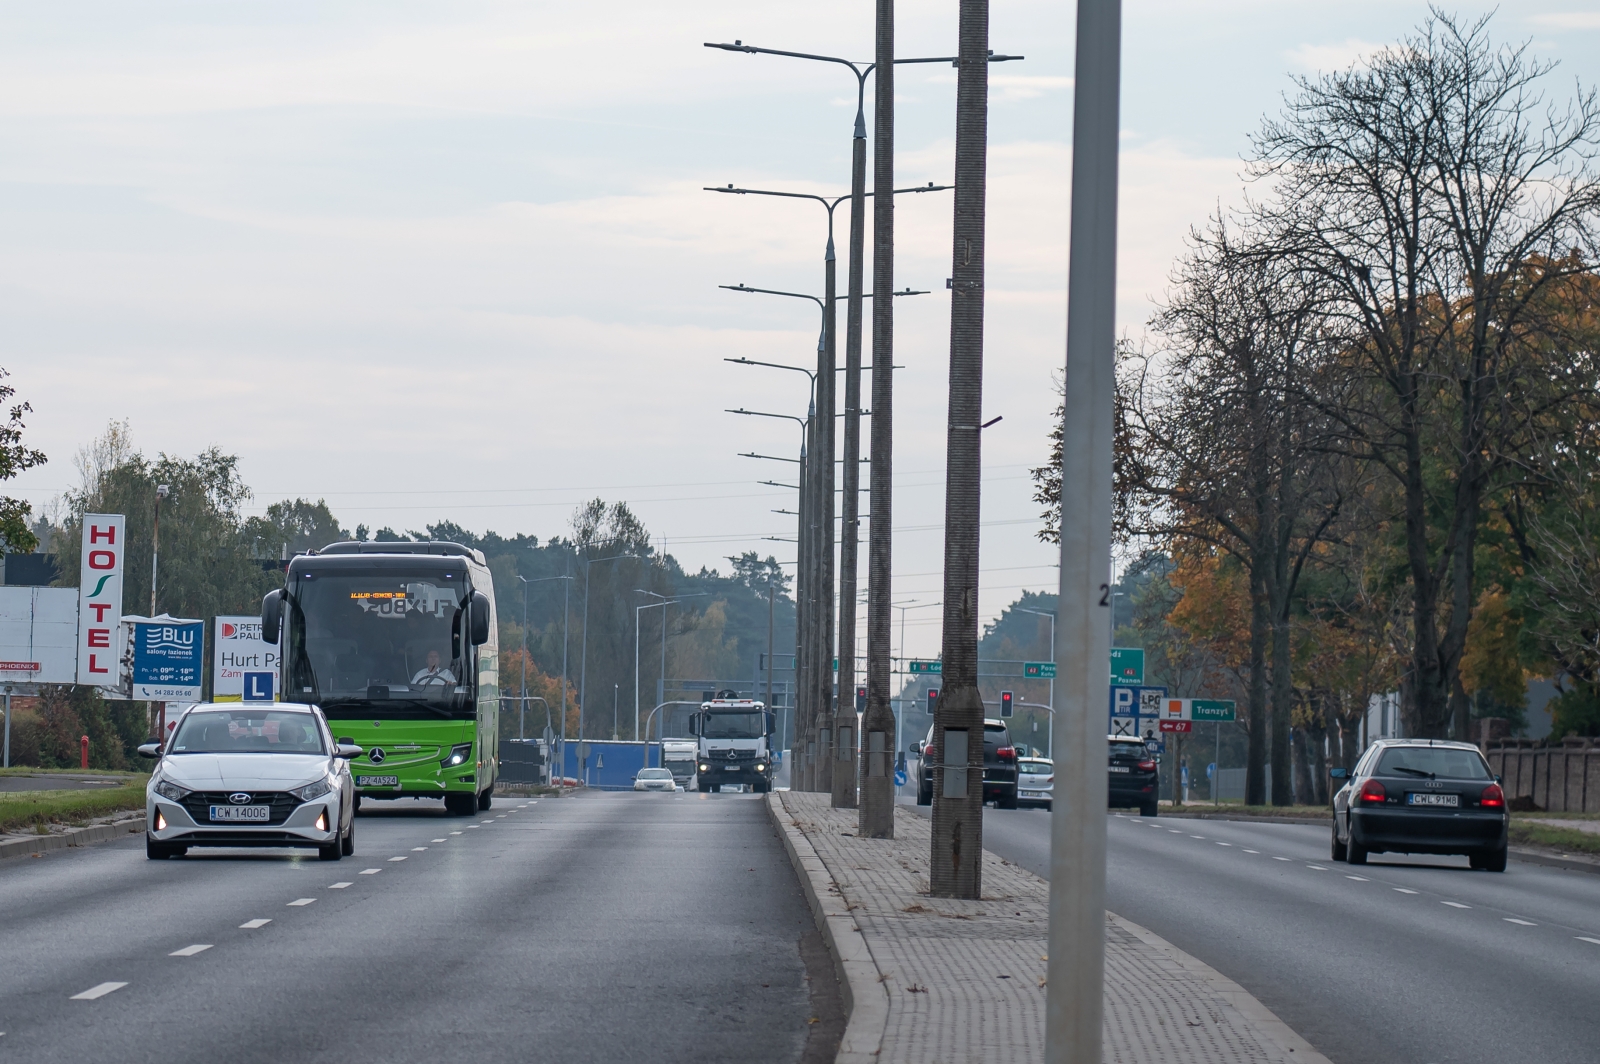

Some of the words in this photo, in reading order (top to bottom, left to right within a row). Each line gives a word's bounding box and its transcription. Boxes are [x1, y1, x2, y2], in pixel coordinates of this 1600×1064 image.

[1099, 583, 1109, 606] 2
[162, 627, 194, 645] BLU
[146, 648, 167, 656] salony
[221, 652, 259, 667] Hurt
[252, 676, 265, 697] L
[1196, 706, 1229, 717] Tranzyt
[1175, 723, 1186, 731] 67
[1414, 794, 1432, 804] CWL
[1435, 795, 1457, 805] 91M8
[217, 807, 231, 818] CW
